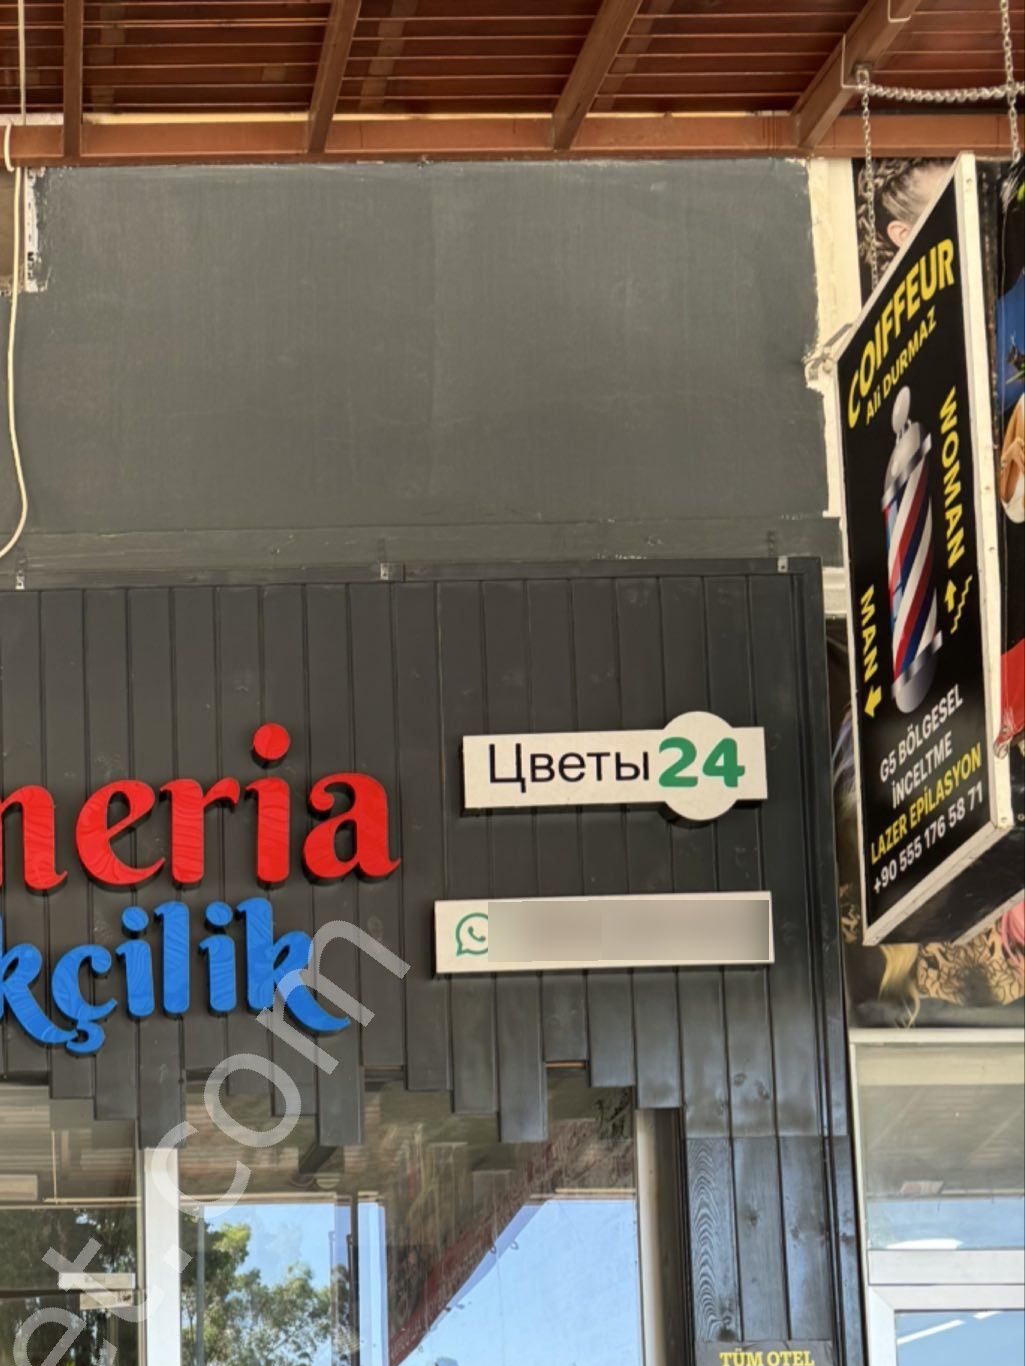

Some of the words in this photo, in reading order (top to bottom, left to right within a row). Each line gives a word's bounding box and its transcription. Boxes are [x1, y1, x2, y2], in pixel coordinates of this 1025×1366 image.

[848, 238, 955, 428] COIFFEUR
[882, 304, 937, 399] DURMAZ
[939, 385, 965, 569] WOMAN
[860, 584, 878, 682] MAN
[880, 751, 897, 783] G5
[898, 683, 963, 766] BÖLGESEL
[891, 730, 953, 809] İNCELTME
[871, 813, 908, 865] LAZER
[910, 742, 982, 829] EPİLASYON
[873, 859, 897, 893] +90
[899, 835, 923, 872] 555
[924, 815, 946, 849] 176
[949, 797, 966, 828] 58
[967, 781, 984, 811] 71
